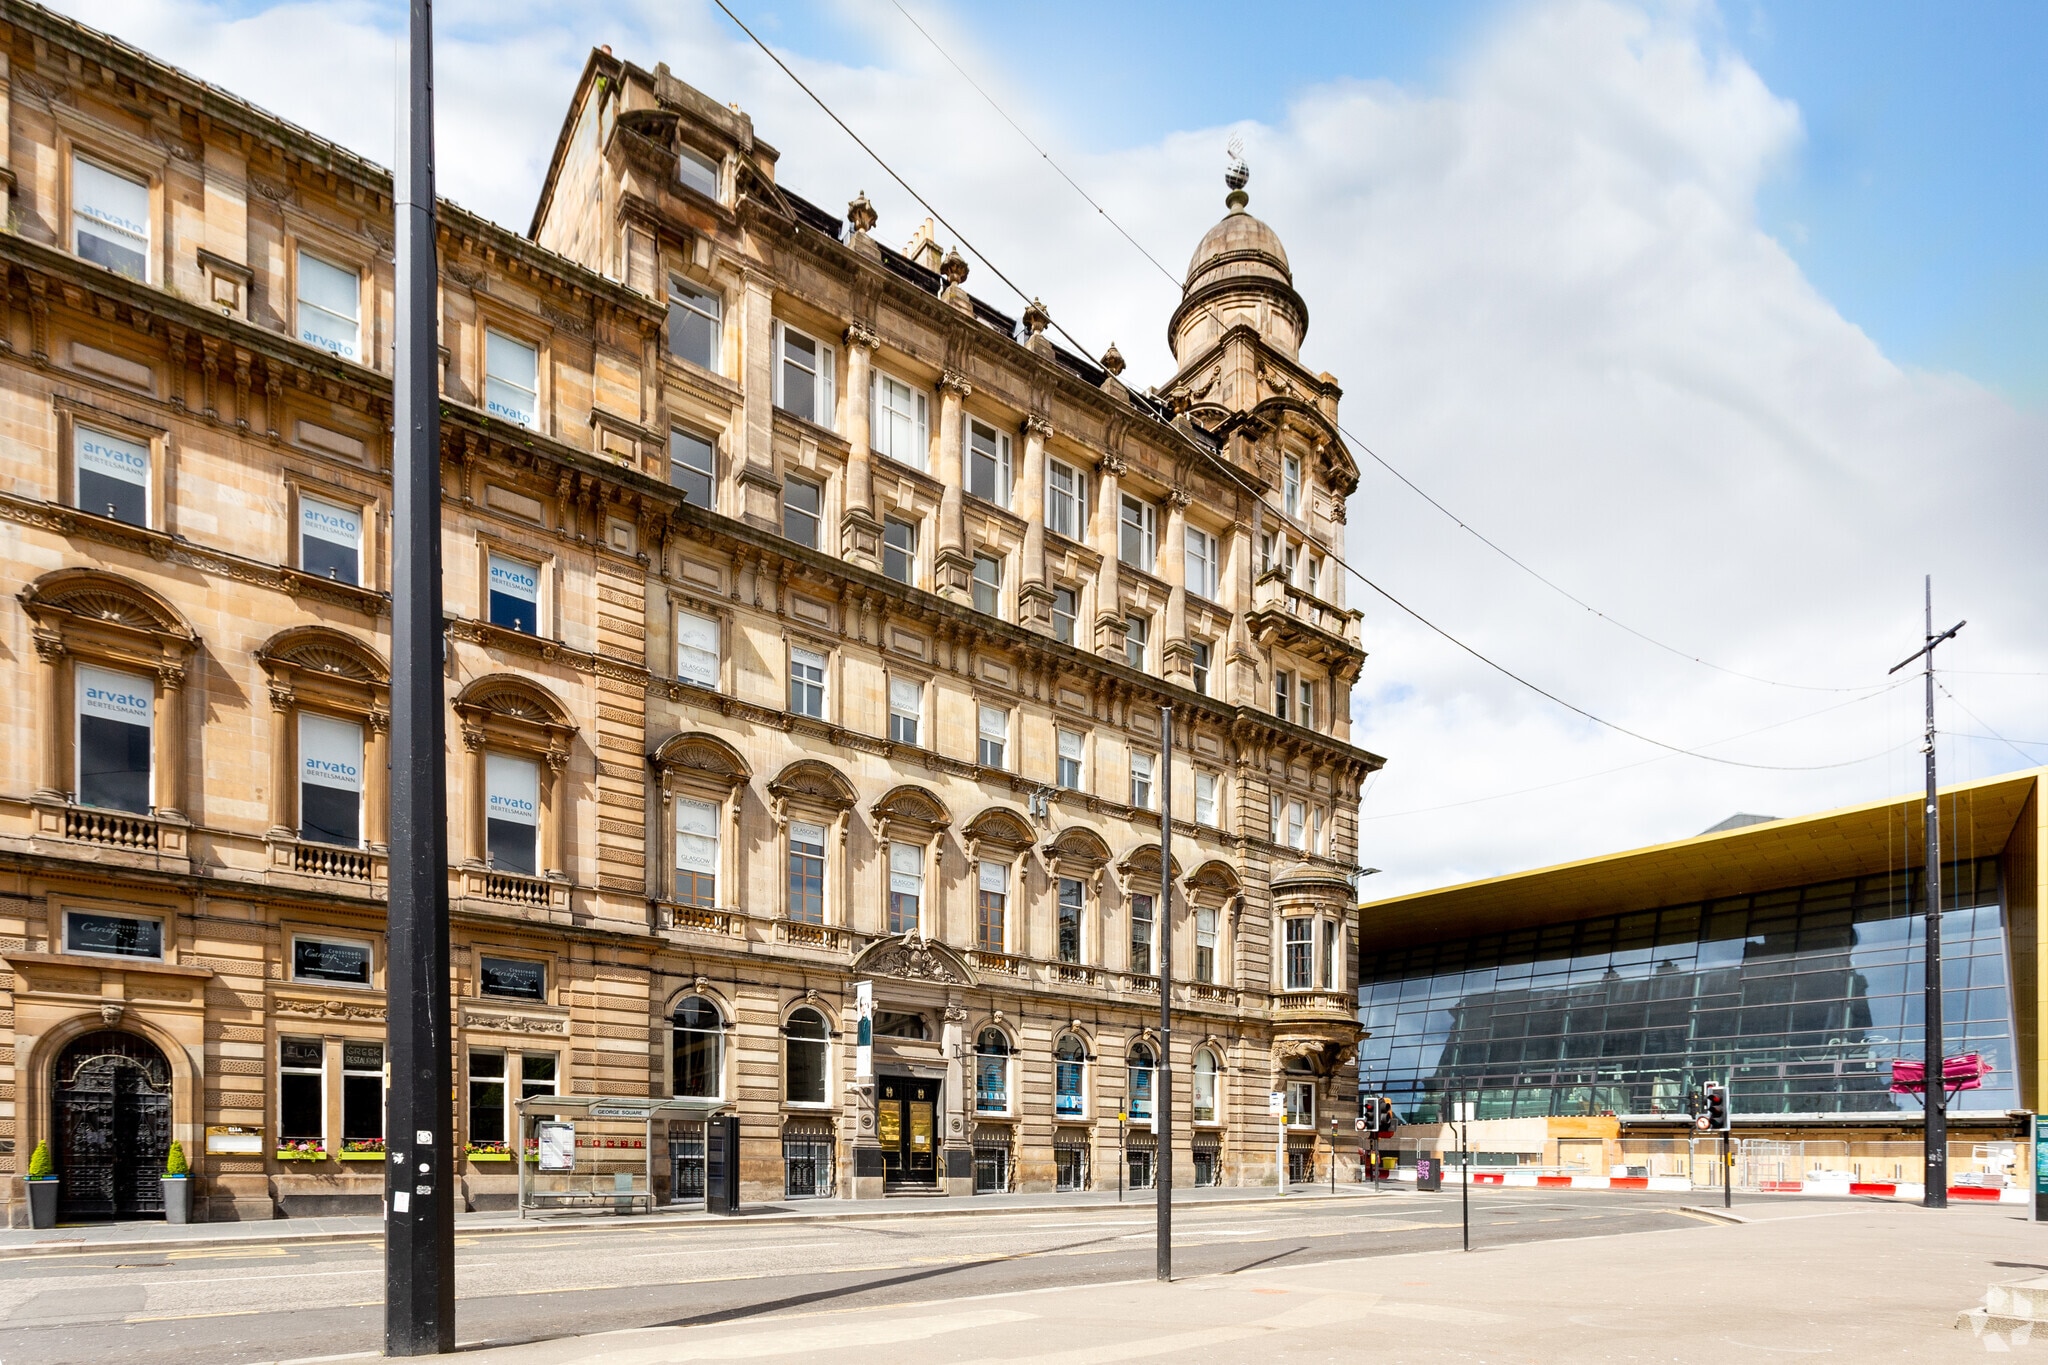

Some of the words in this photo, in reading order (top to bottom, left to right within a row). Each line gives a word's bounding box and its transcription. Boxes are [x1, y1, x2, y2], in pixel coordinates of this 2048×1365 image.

[83, 204, 144, 235] arvato
[303, 330, 353, 356] arvato
[488, 401, 531, 424] arvato
[83, 441, 144, 468] arvato
[84, 453, 144, 477] BERTELSMANN
[304, 509, 355, 532] arvato
[305, 520, 355, 540] BERTELSMANN
[491, 566, 533, 587] arvato
[491, 576, 533, 594] BERTELSMANN
[681, 661, 711, 675] GLASGOW
[86, 687, 147, 709] arvato
[87, 699, 147, 717] BERTELSMANN
[306, 758, 357, 776] arvato
[306, 769, 356, 783] BERTELSMANN
[490, 794, 533, 811] arvato
[490, 804, 533, 818] BERTELSMANN
[681, 854, 711, 865] GLASGOW
[81, 921, 118, 942] Caring
[109, 922, 150, 932] Crossroads
[304, 948, 335, 967] Caring
[328, 948, 361, 957] Crossroads
[488, 967, 516, 984] Caring
[509, 967, 537, 975] Crossroads
[347, 1046, 380, 1057] GREEK
